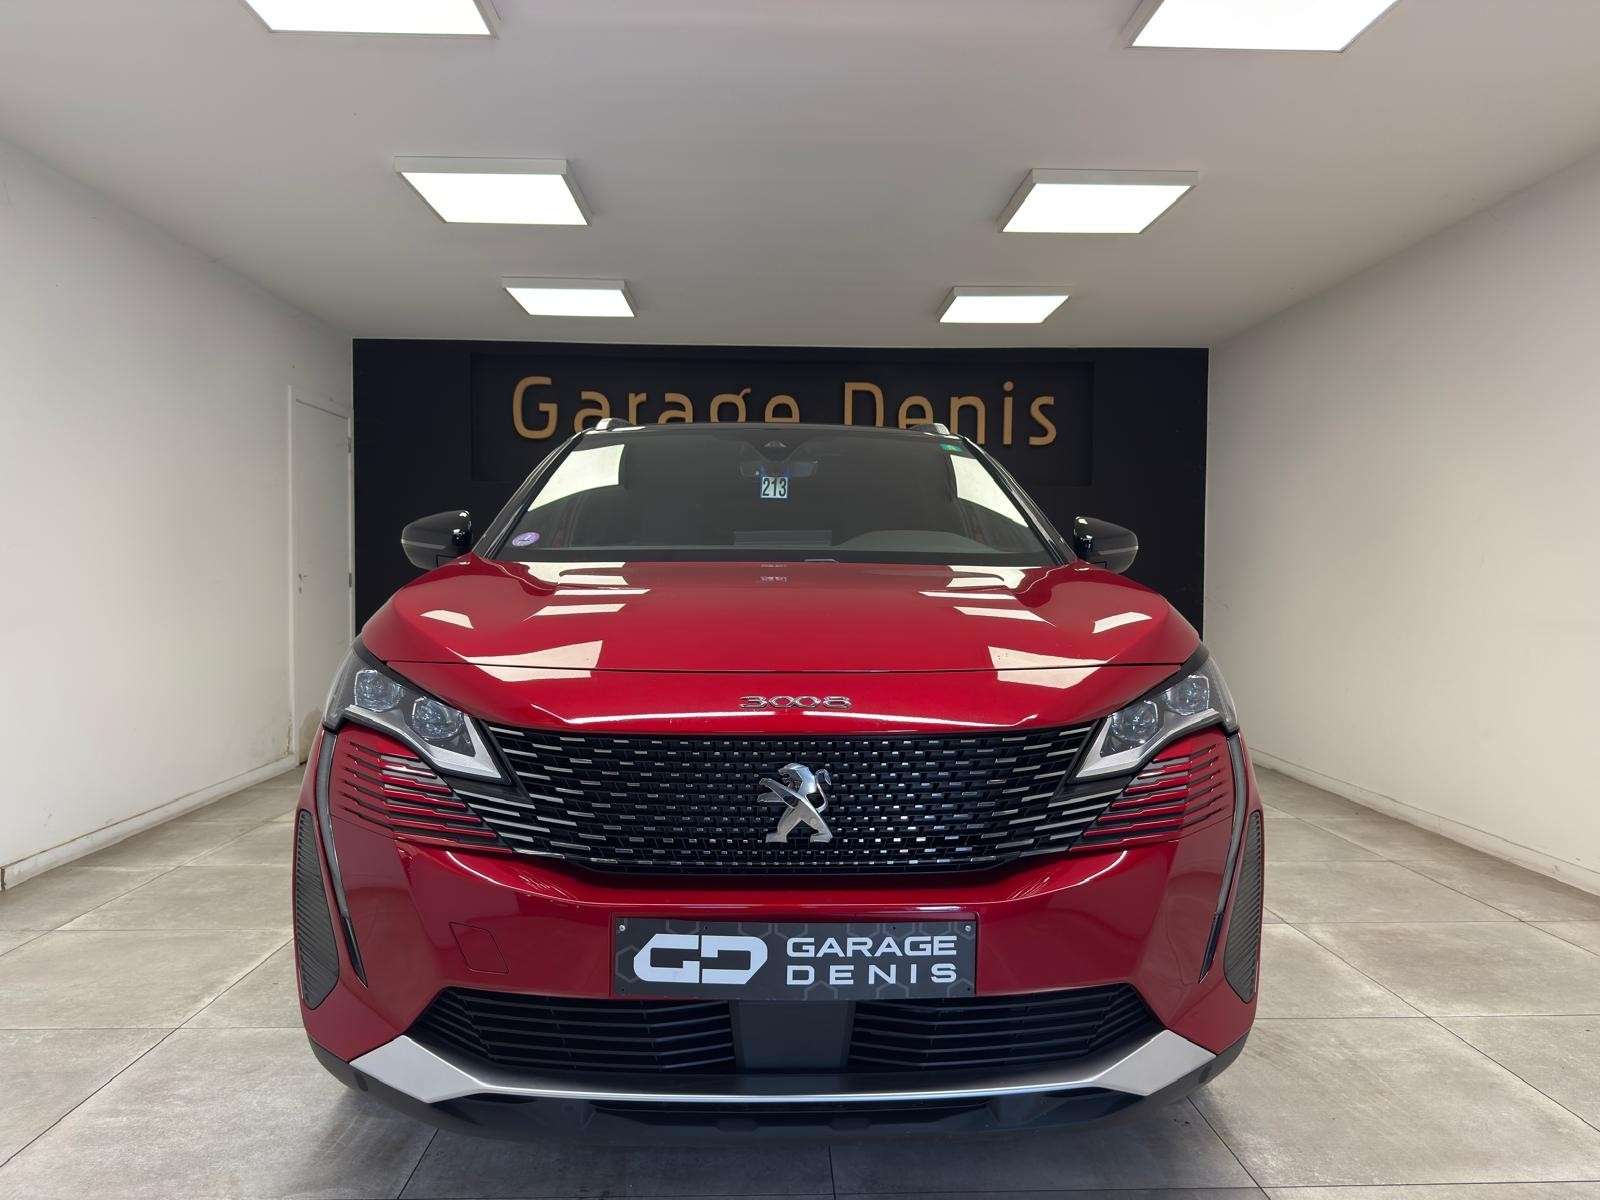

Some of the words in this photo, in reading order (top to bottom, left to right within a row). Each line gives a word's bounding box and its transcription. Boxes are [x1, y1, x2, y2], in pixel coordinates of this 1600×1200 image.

[512, 375, 800, 440] Garage
[844, 380, 1057, 446] Denis
[762, 477, 787, 497] 213
[740, 695, 851, 708] 3008
[786, 935, 957, 958] GARAGE
[786, 963, 957, 985] DENIS
